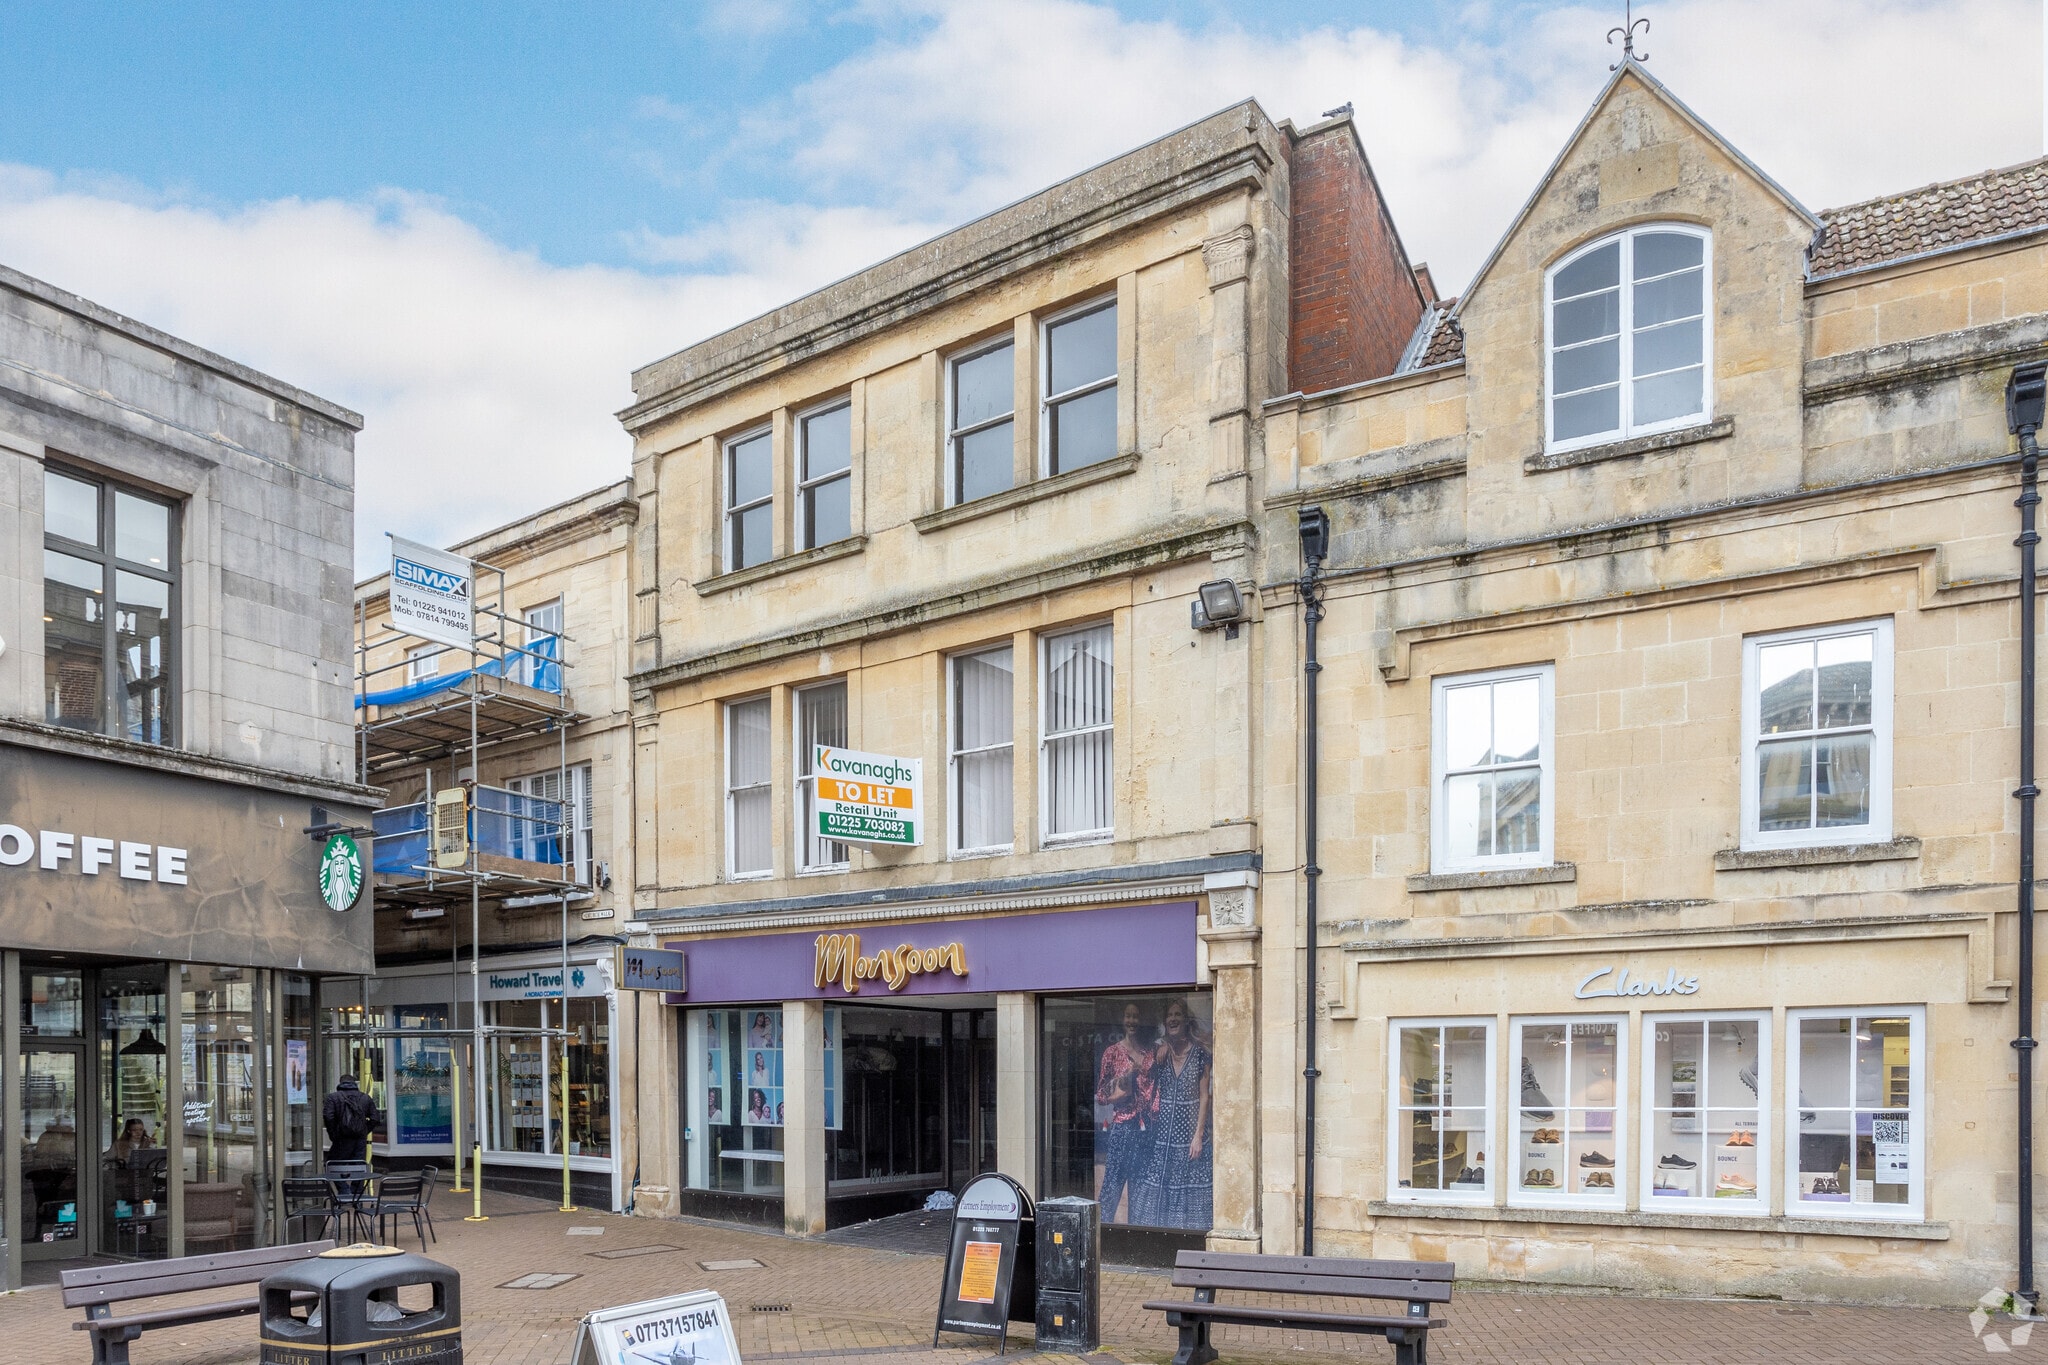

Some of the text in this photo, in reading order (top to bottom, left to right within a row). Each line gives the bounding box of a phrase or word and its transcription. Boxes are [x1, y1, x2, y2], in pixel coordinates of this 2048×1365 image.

[397, 561, 466, 596] SIMAX
[394, 578, 468, 602] SCAFFOLDING.CO.UK
[394, 604, 469, 631] Mob: 07814 799495
[396, 594, 411, 605] Tel:
[412, 599, 436, 613] 01225
[437, 606, 466, 620] 941012
[817, 747, 912, 785] Kavanaghs
[836, 781, 895, 805] TO LET
[835, 803, 898, 819] Retail Unit
[828, 815, 905, 833] 01225 703082
[828, 826, 906, 840] www.kavanaghs.co.uk
[626, 958, 681, 980] Monsoon
[814, 933, 969, 992] Monsoon
[489, 970, 563, 989] Howard Travel
[1574, 966, 1700, 999] Clarks
[183, 1099, 214, 1110] Additional
[1872, 1112, 1909, 1120] DISCOVER
[980, 1199, 1010, 1214] Employment
[635, 1308, 719, 1343] 07737157841
[274, 1353, 310, 1365] LITTER
[382, 1344, 432, 1361] LITTER
